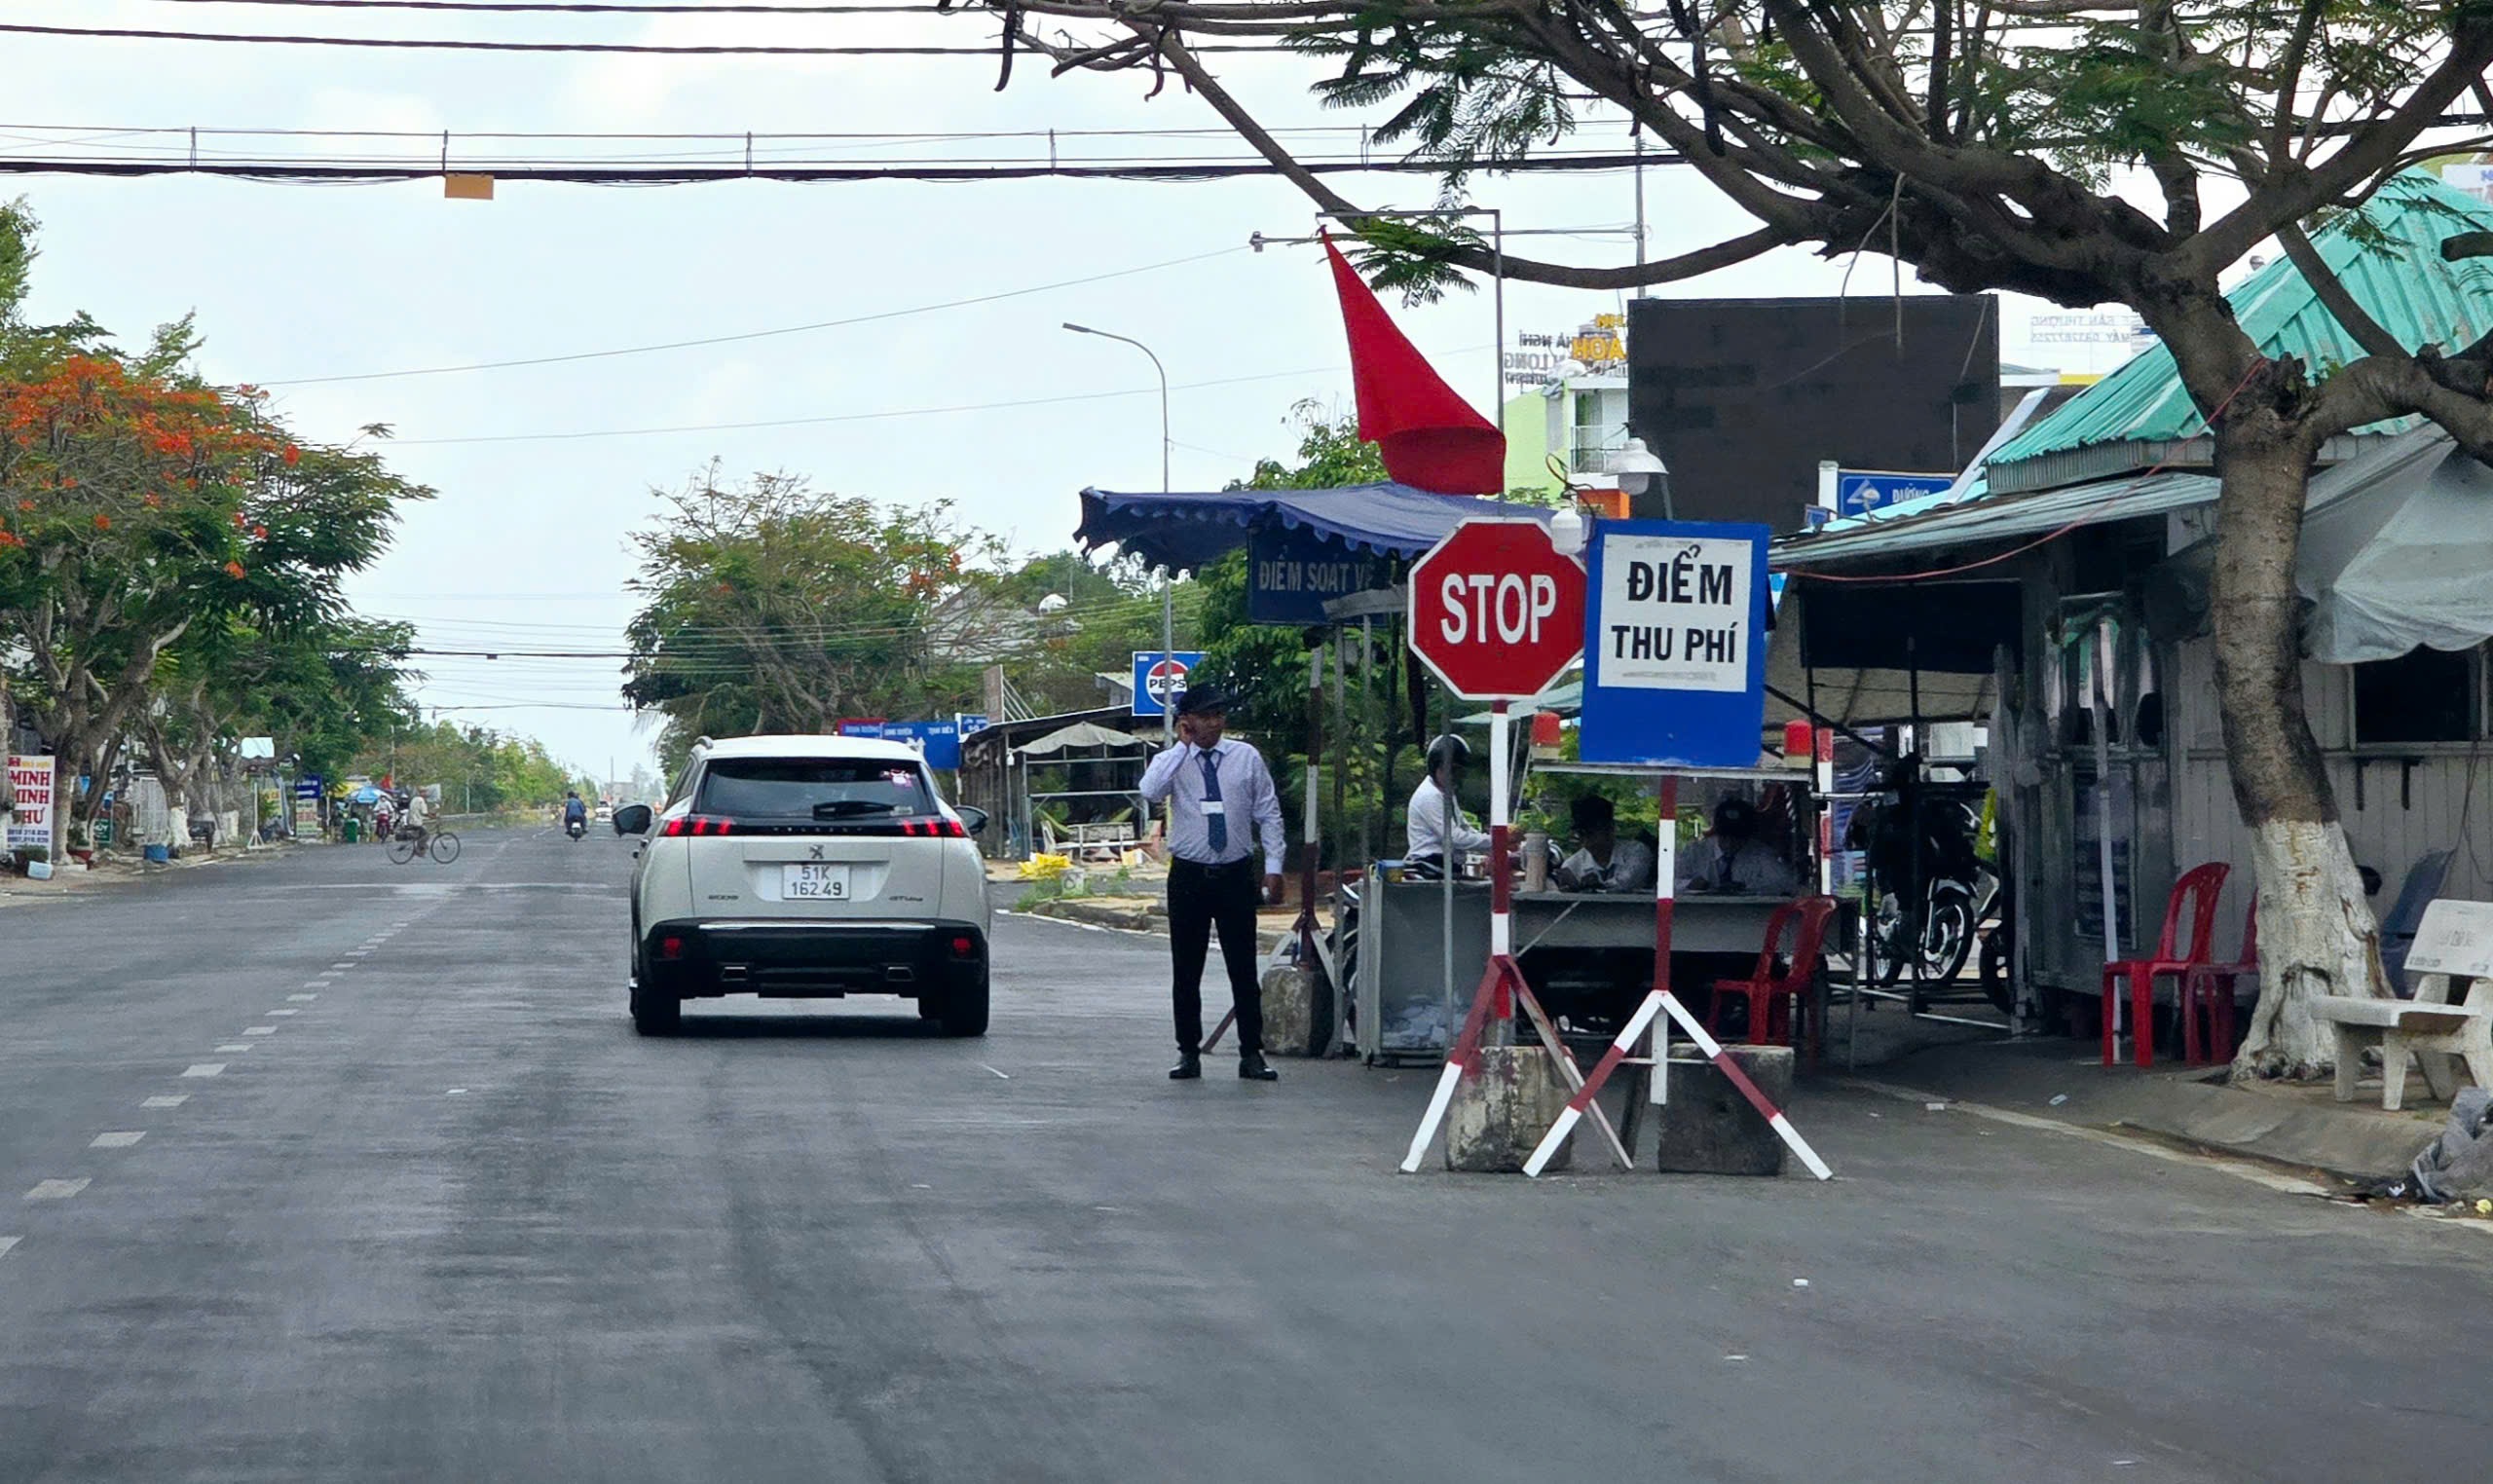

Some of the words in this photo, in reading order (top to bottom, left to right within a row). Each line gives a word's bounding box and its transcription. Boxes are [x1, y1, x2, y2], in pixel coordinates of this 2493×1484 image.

[1259, 544, 1301, 591] ĐIỂM
[1307, 553, 1350, 592] SOÁT
[1626, 544, 1733, 605] ĐIỂM
[1440, 574, 1556, 645] STOP
[1611, 625, 1673, 661] THU
[1685, 622, 1737, 663] PHÍ
[1149, 679, 1187, 688] PEPS
[9, 770, 51, 786] MINH
[802, 866, 831, 880] 51K
[792, 881, 842, 896] 162.49
